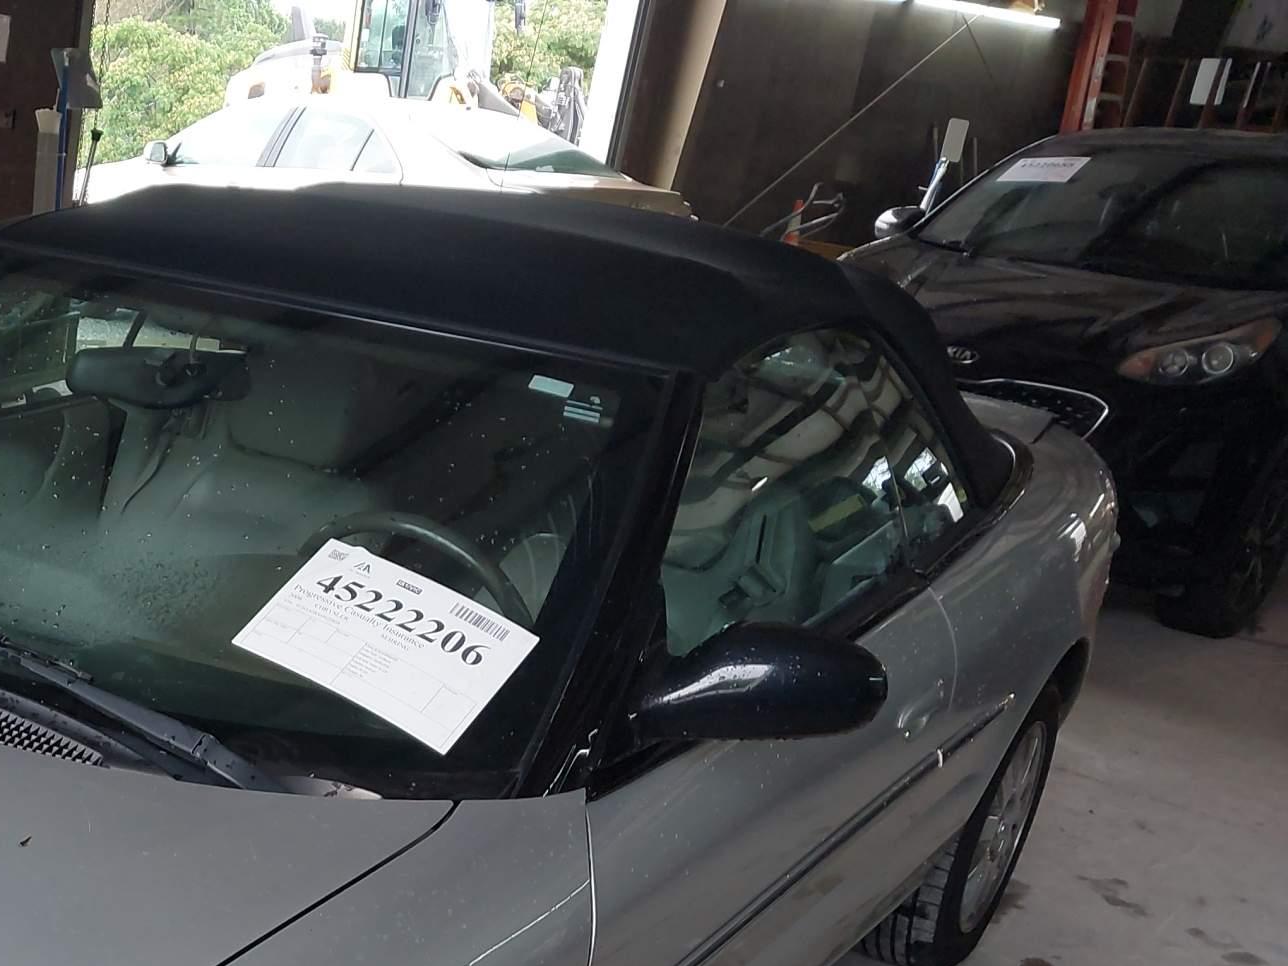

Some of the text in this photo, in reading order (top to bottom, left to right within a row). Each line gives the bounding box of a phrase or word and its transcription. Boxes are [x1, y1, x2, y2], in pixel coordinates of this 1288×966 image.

[294, 584, 344, 609] Progressive
[344, 605, 383, 627] Casualty
[382, 622, 425, 649] Insurance
[316, 575, 491, 665] 45222206
